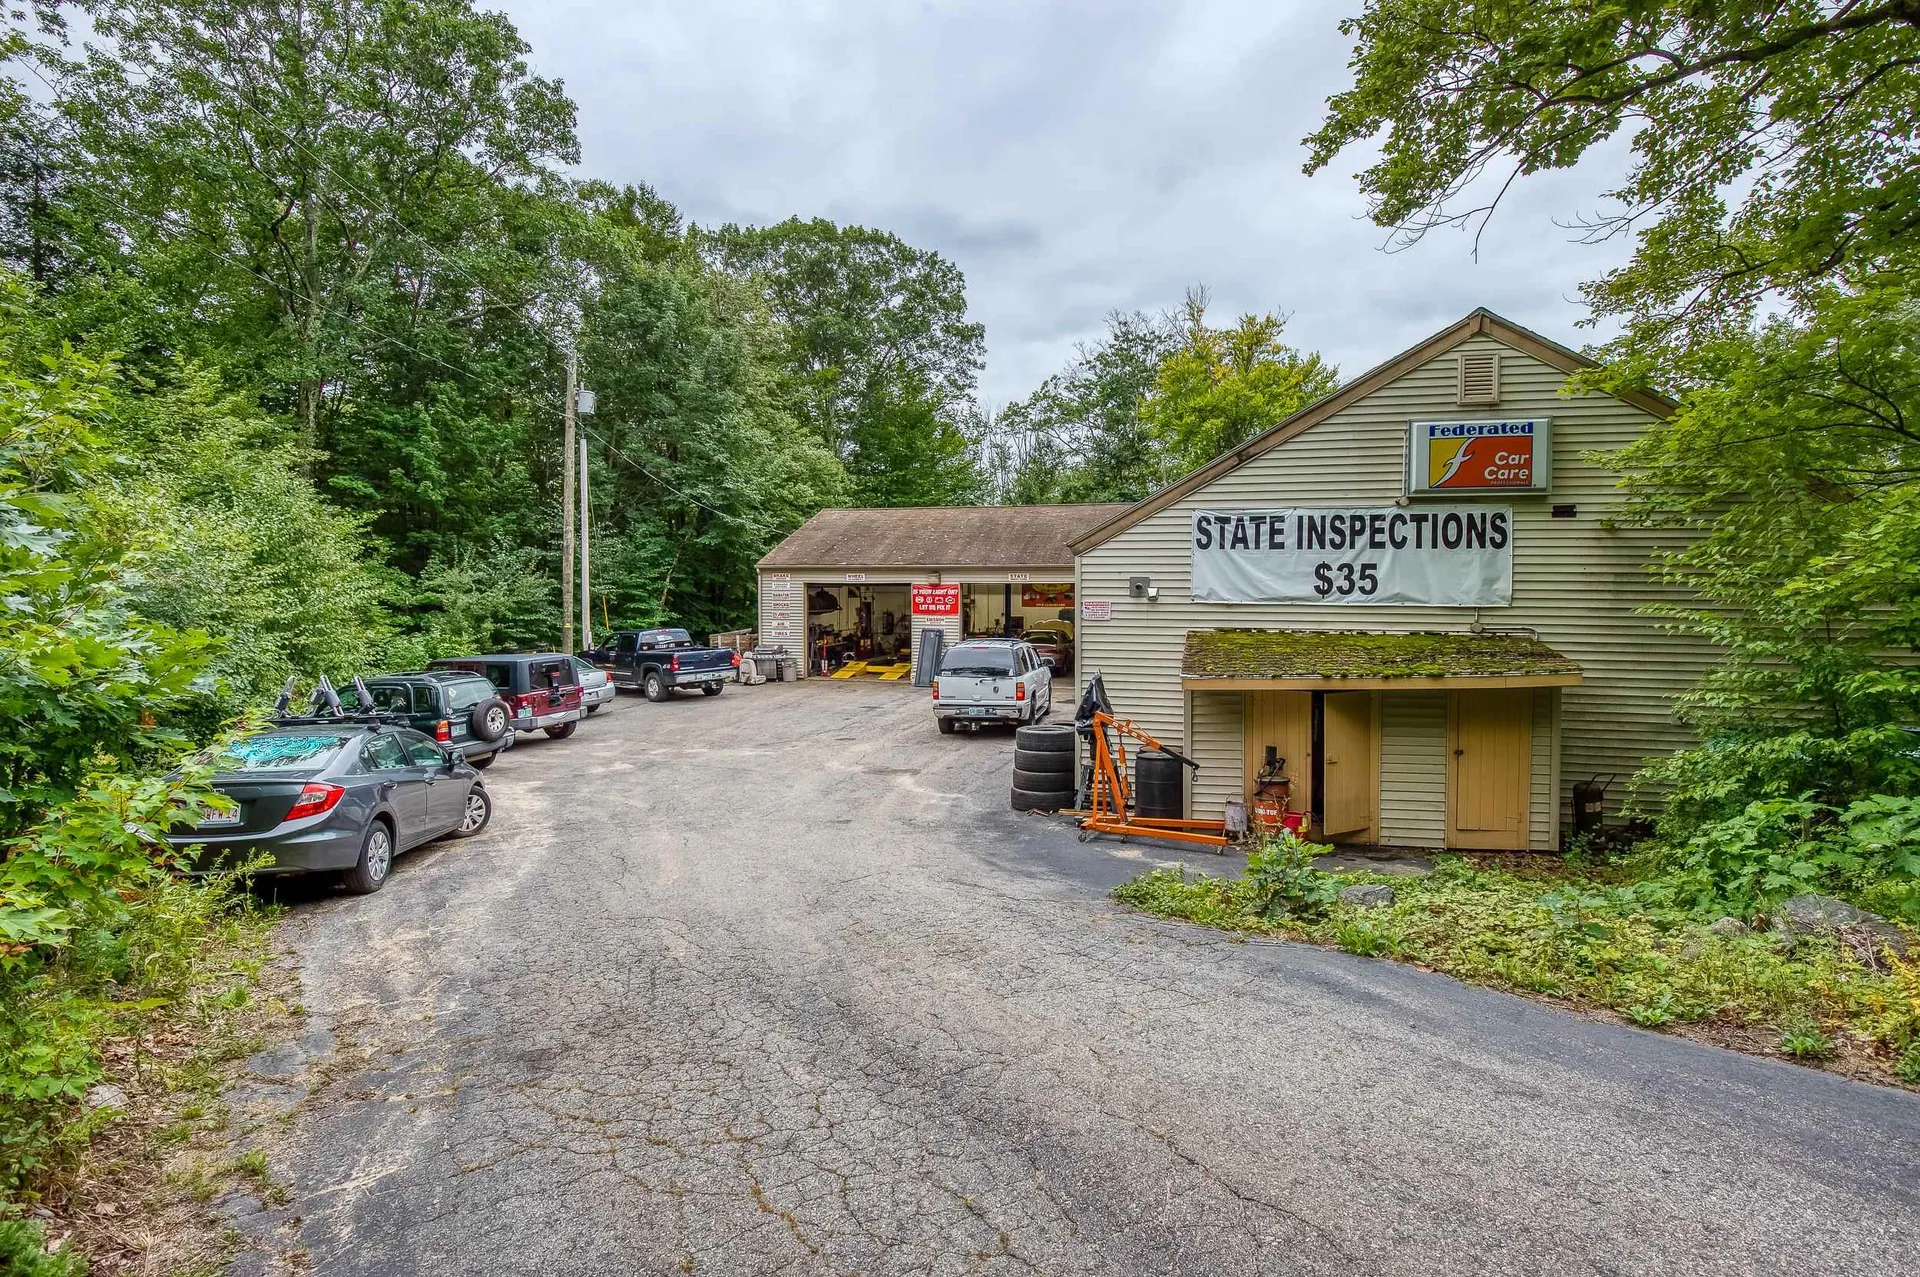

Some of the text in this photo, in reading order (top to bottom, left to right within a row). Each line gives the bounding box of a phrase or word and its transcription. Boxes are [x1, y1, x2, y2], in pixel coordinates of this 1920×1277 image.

[1429, 422, 1534, 437] Federated
[1494, 451, 1530, 465] Car
[1484, 466, 1529, 480] Care
[1195, 511, 1508, 551] STATE INSPECTIONS
[1313, 561, 1379, 599] $35
